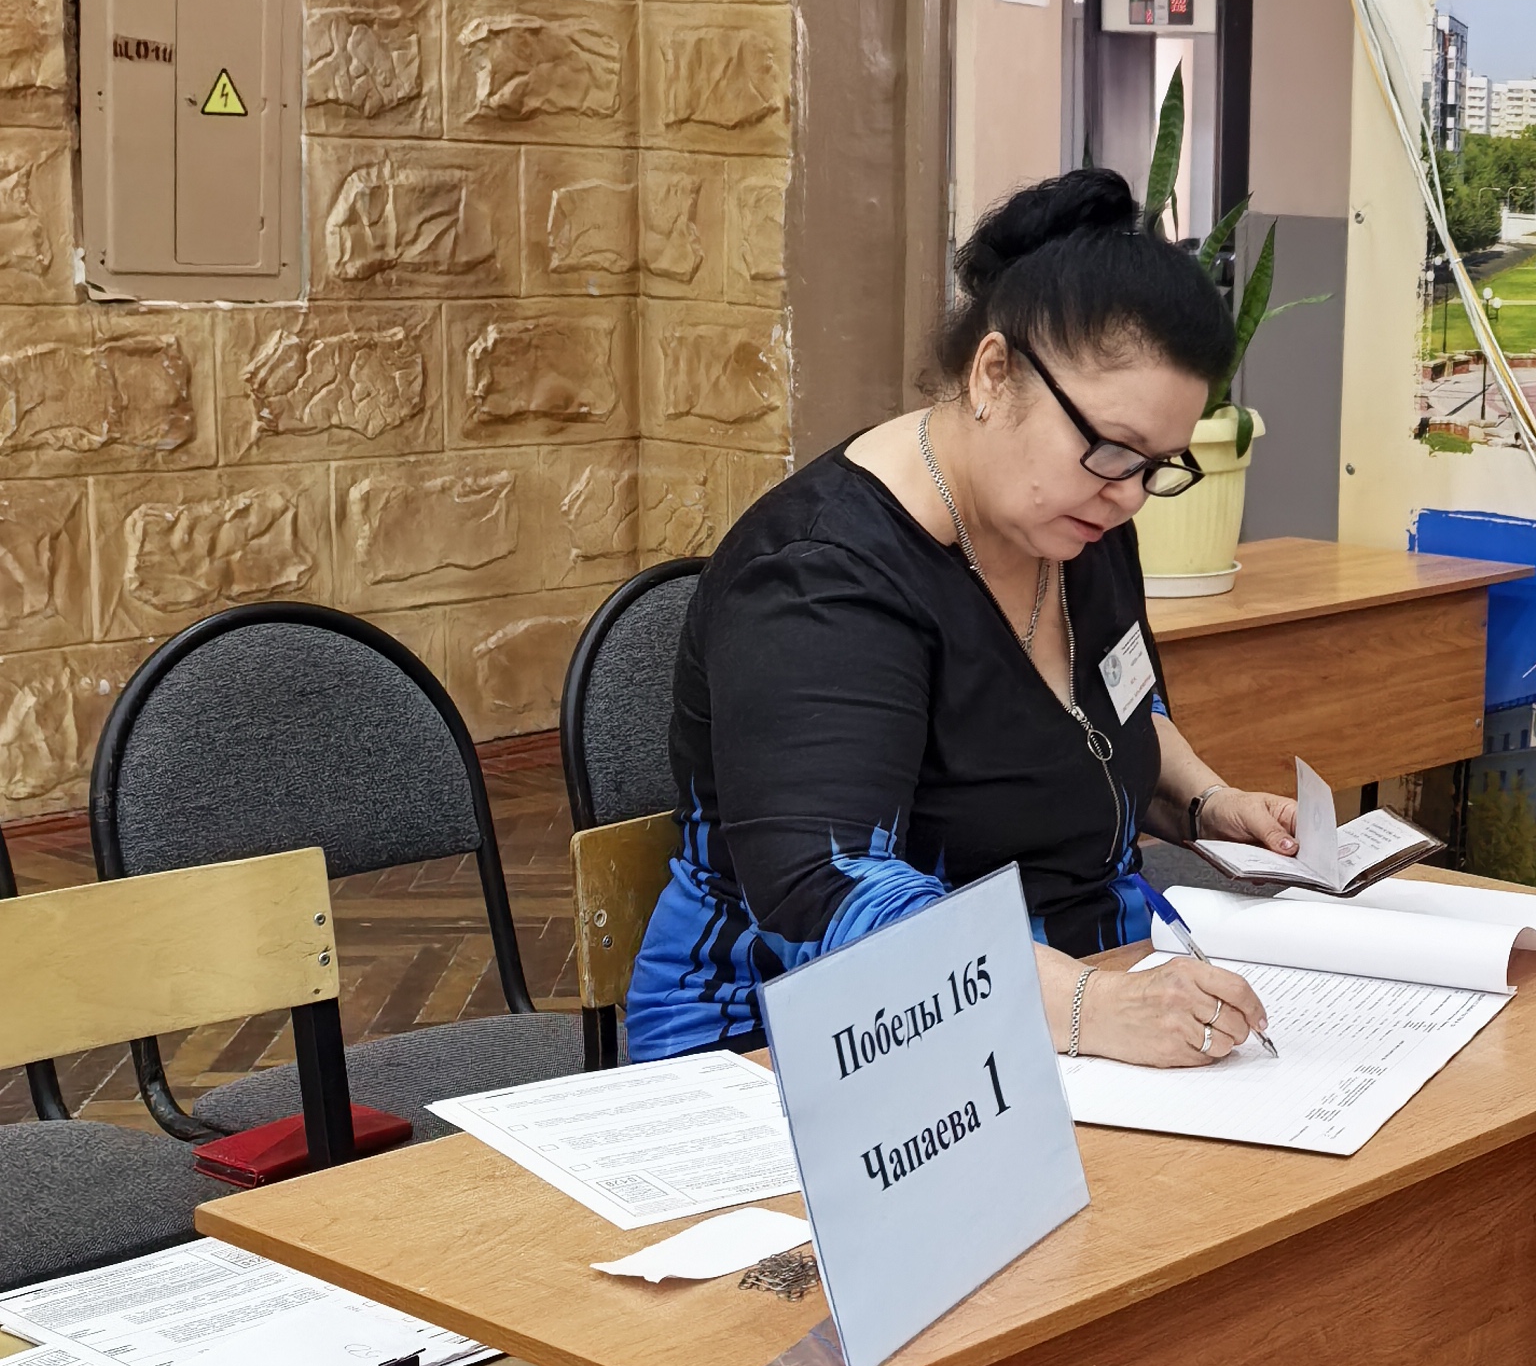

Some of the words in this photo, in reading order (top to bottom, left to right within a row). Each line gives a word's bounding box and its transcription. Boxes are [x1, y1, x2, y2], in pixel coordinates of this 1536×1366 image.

[831, 993, 943, 1080] Победы
[946, 954, 993, 1016] 165
[860, 1100, 982, 1192] Чапаева
[983, 1050, 1012, 1117] 1
